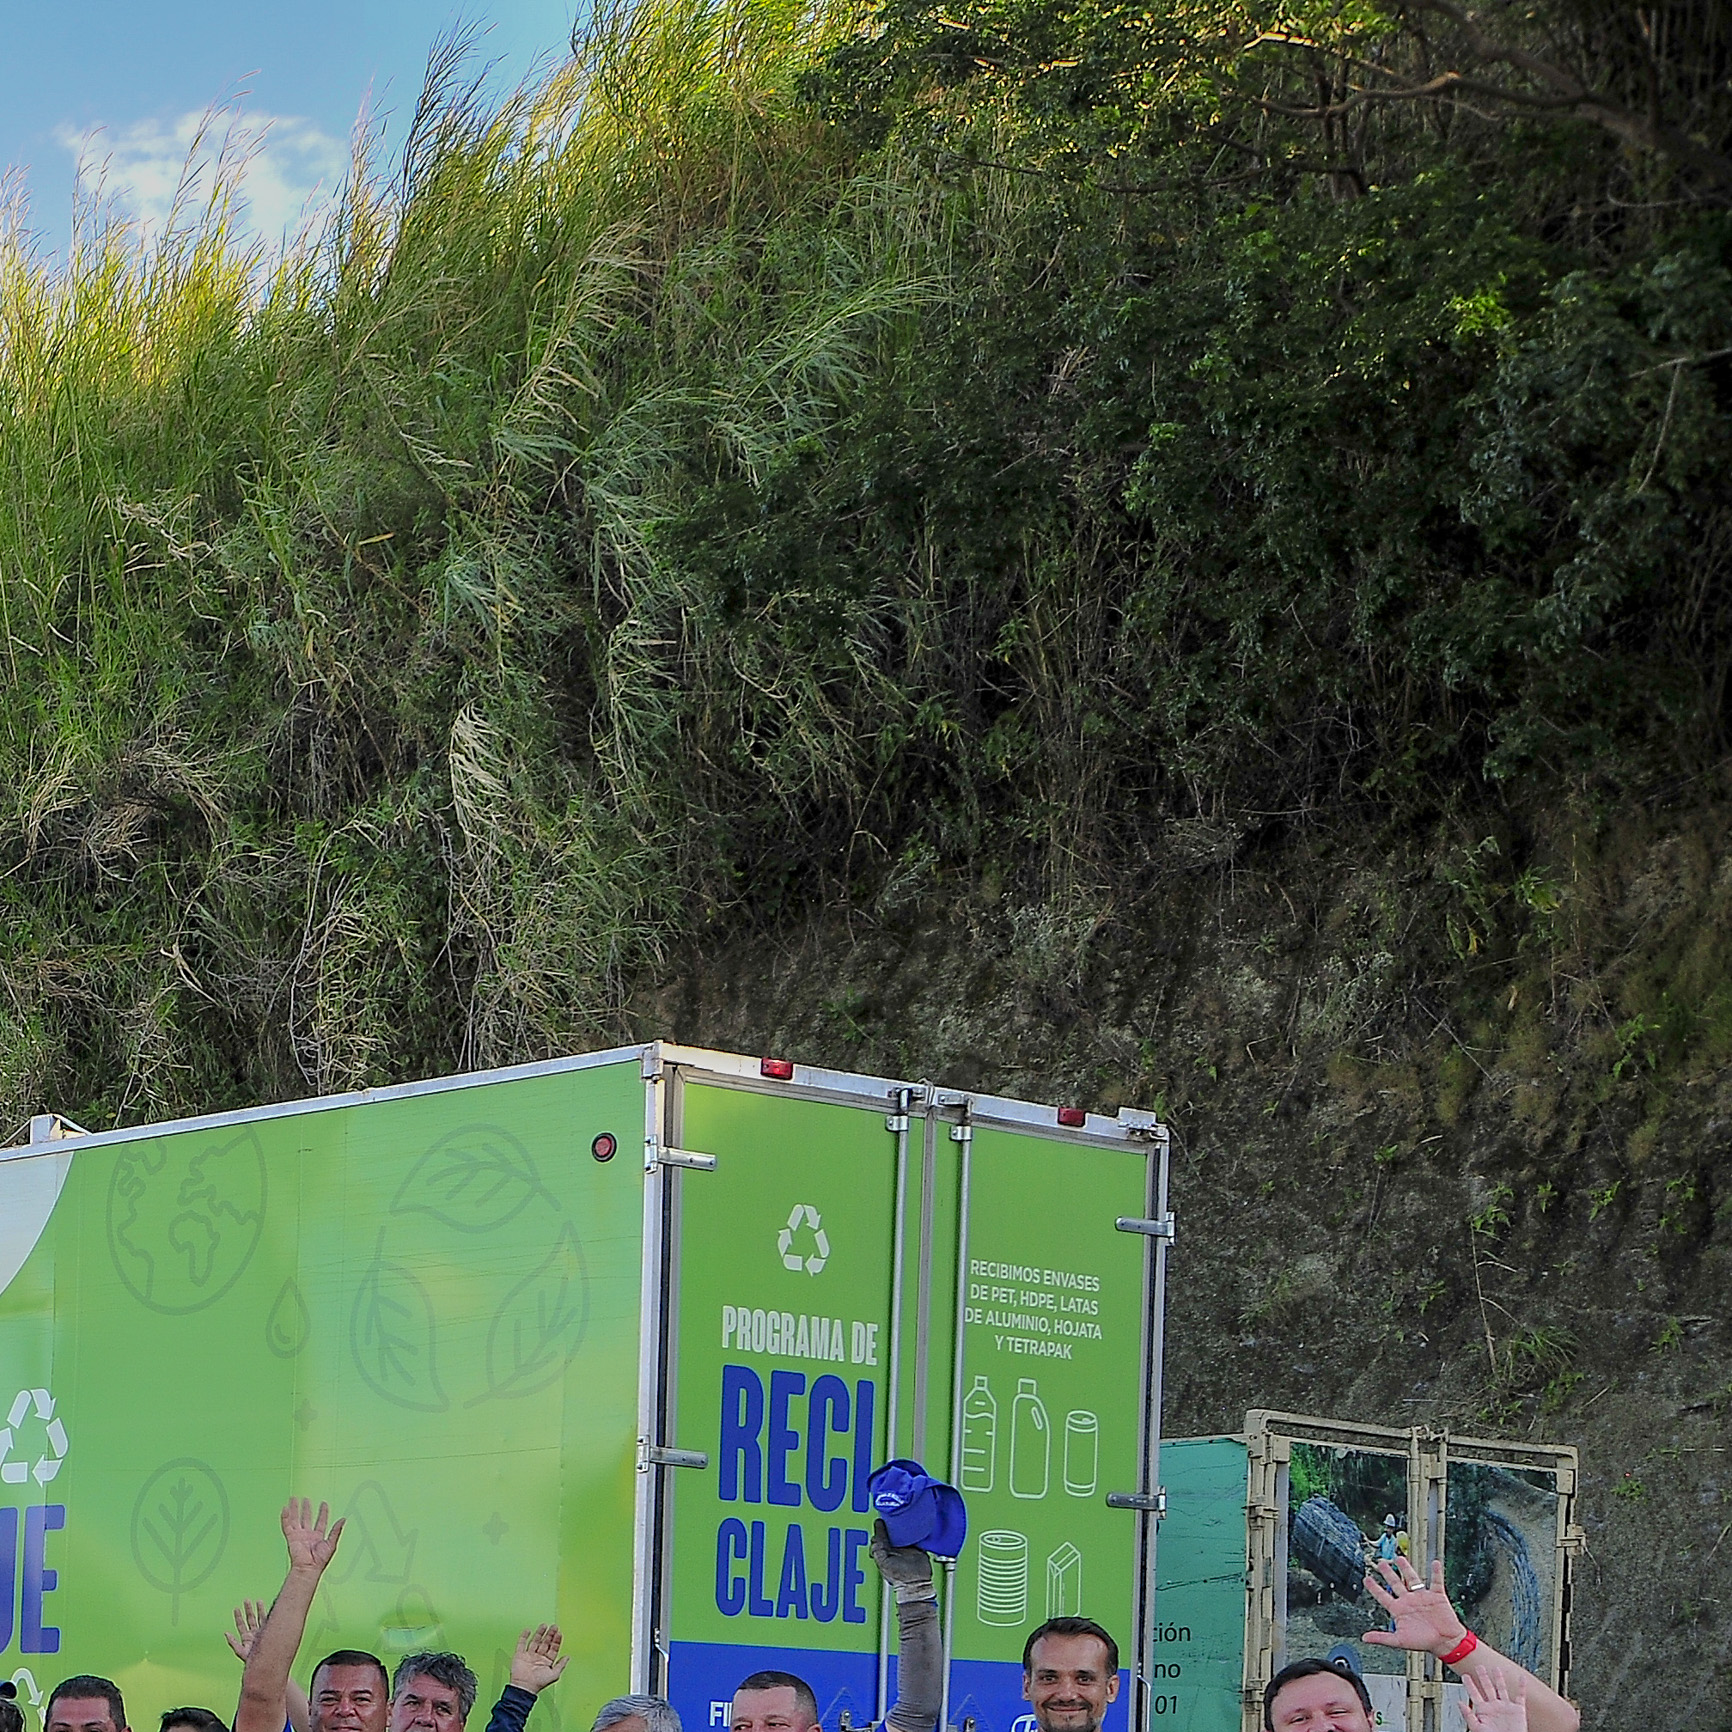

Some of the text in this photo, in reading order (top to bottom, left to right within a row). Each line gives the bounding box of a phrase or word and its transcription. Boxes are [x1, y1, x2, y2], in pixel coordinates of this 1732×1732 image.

[970, 1259, 1100, 1292] RECIBIMOS ENVASES
[970, 1283, 1098, 1316] DE PET, HDPE, LATAS
[721, 1304, 878, 1367] PROGRAMA DE
[964, 1307, 1102, 1340] DE ALUMINIO, HOJATA
[994, 1335, 1072, 1360] Y TETRAPAK
[719, 1364, 875, 1515] RECI
[714, 1516, 870, 1626] CLAJE
